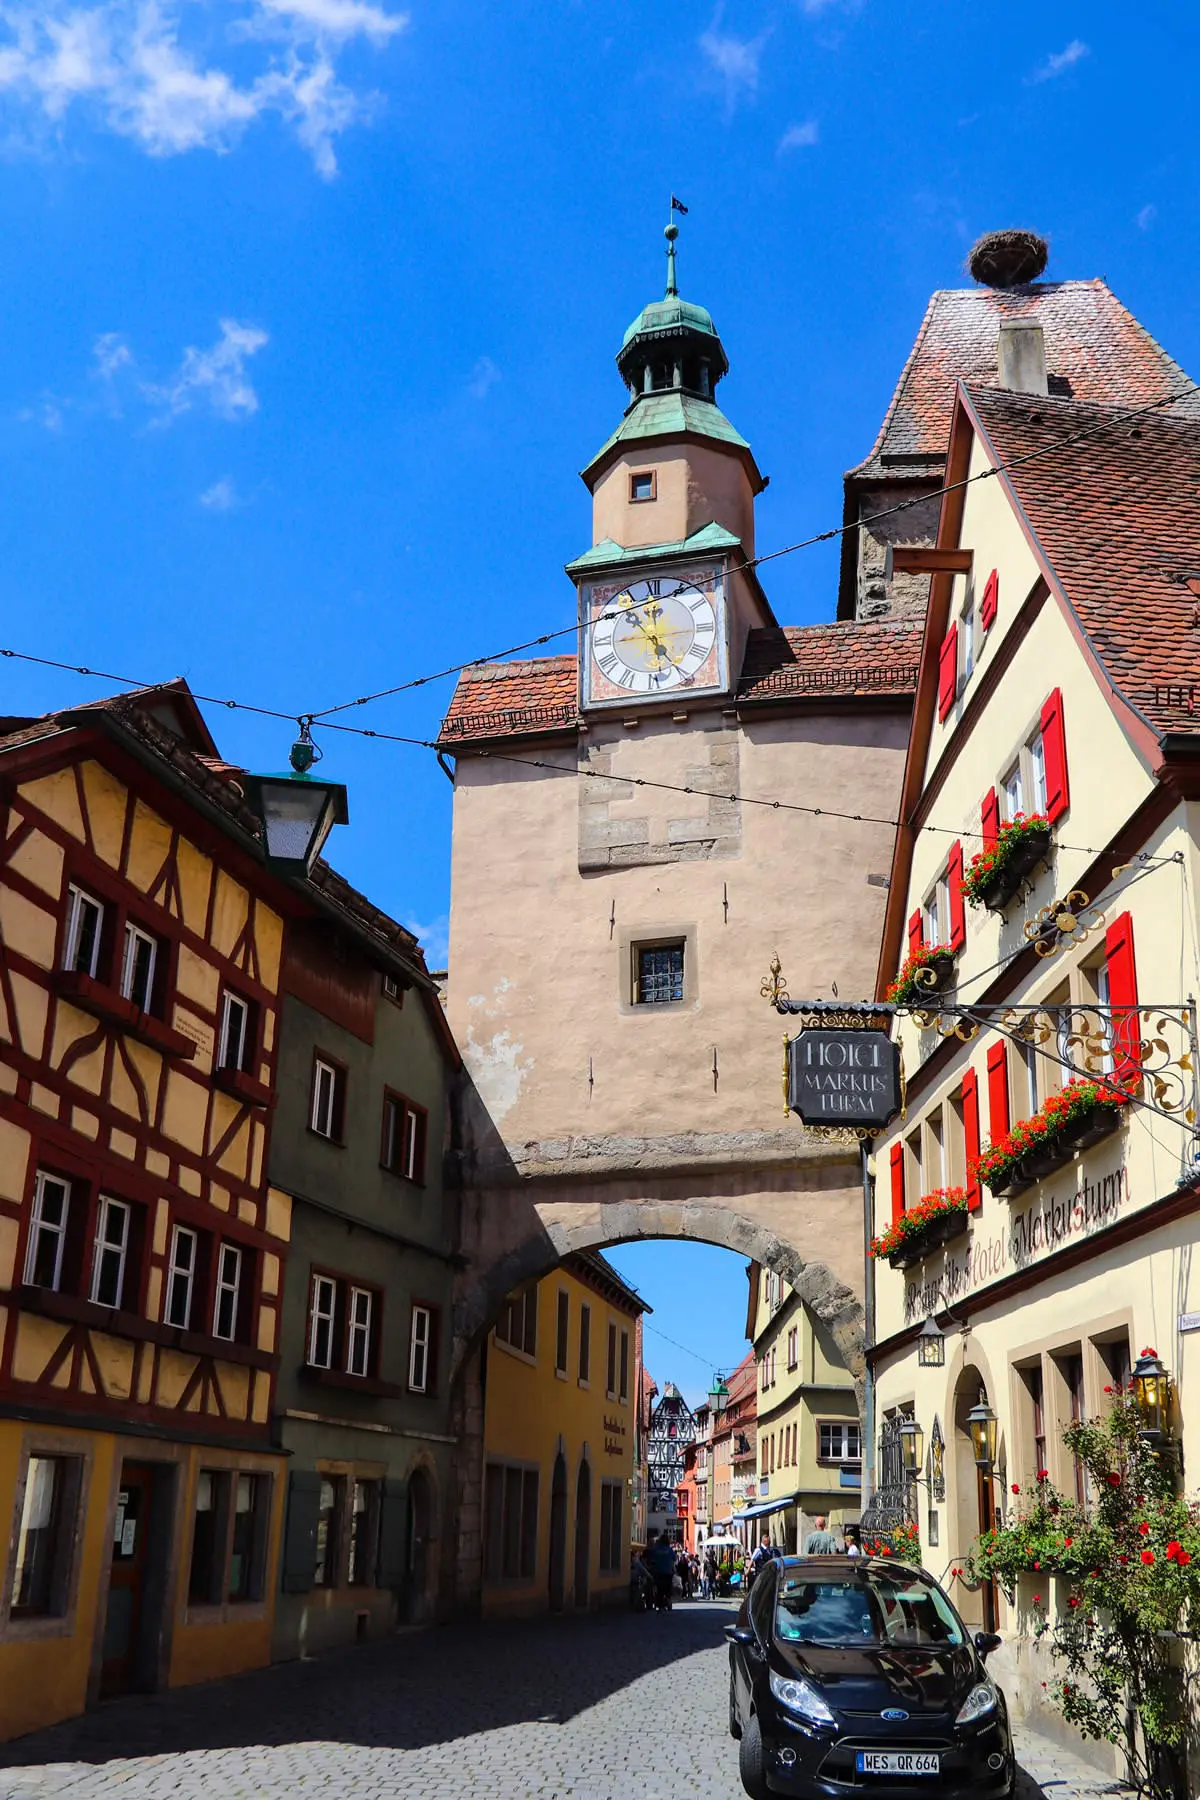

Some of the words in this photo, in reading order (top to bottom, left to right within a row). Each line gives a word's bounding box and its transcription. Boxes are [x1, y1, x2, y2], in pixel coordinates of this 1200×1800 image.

[646, 580, 661, 597] XII
[696, 622, 713, 632] III
[807, 1042, 881, 1067] HOTEL
[805, 1073, 886, 1092] MARKUS
[821, 1094, 875, 1112] TURM
[961, 1227, 1006, 1292] Hotel
[1013, 1165, 1131, 1264] Markusturm
[865, 1755, 889, 1769] WES
[897, 1755, 913, 1770] QR
[915, 1756, 938, 1771] 664
